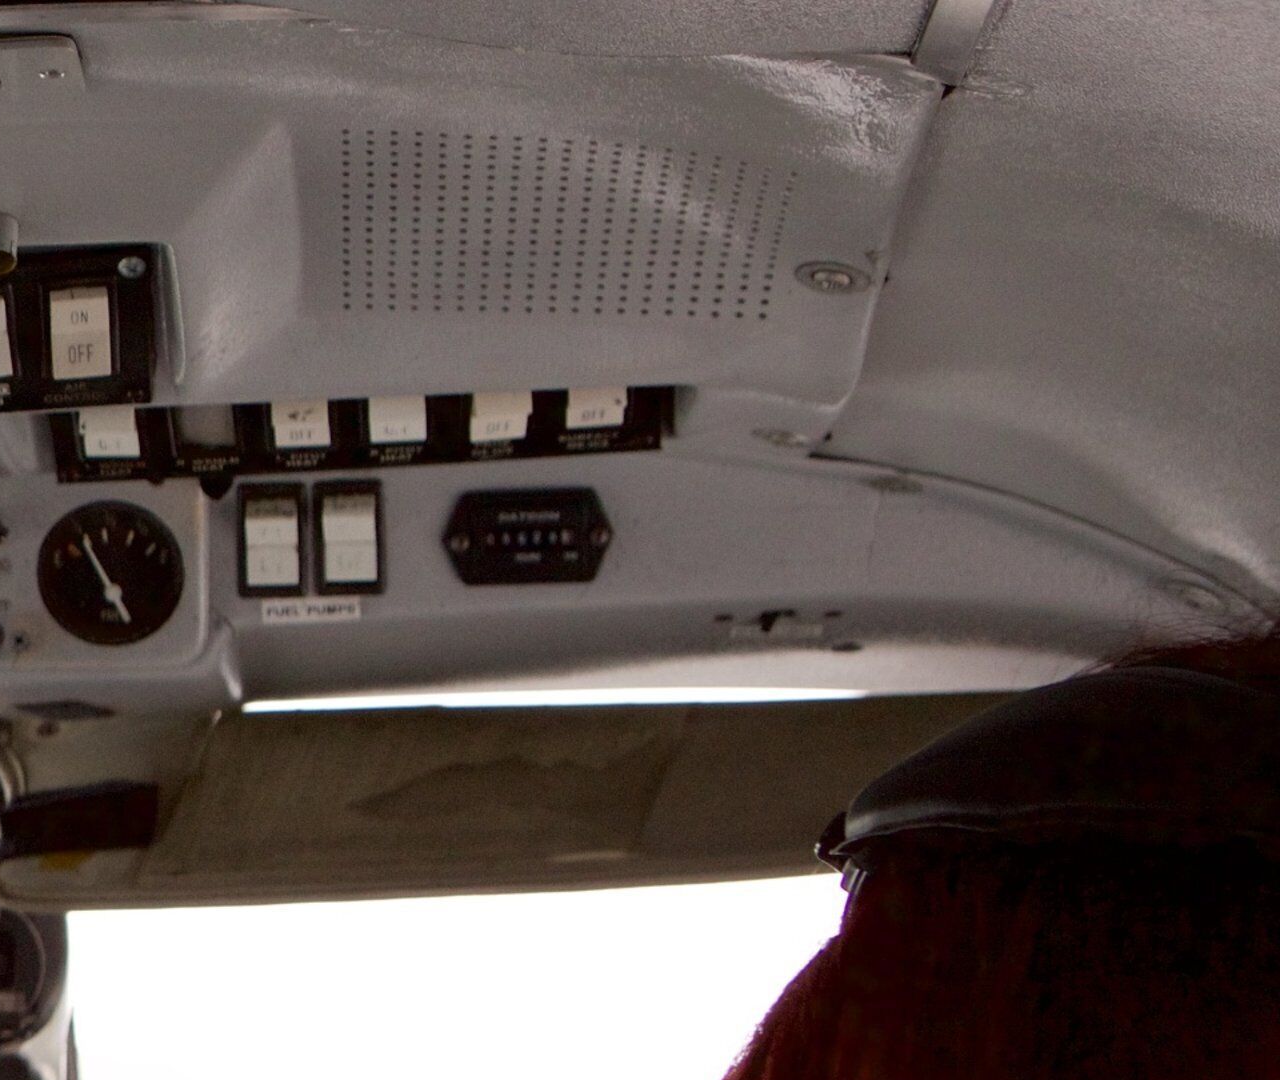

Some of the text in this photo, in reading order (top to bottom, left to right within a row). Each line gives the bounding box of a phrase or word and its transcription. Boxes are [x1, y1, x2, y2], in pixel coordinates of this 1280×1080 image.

[70, 311, 89, 325] ON
[68, 344, 94, 364] OFF
[266, 605, 299, 617] FUEL
